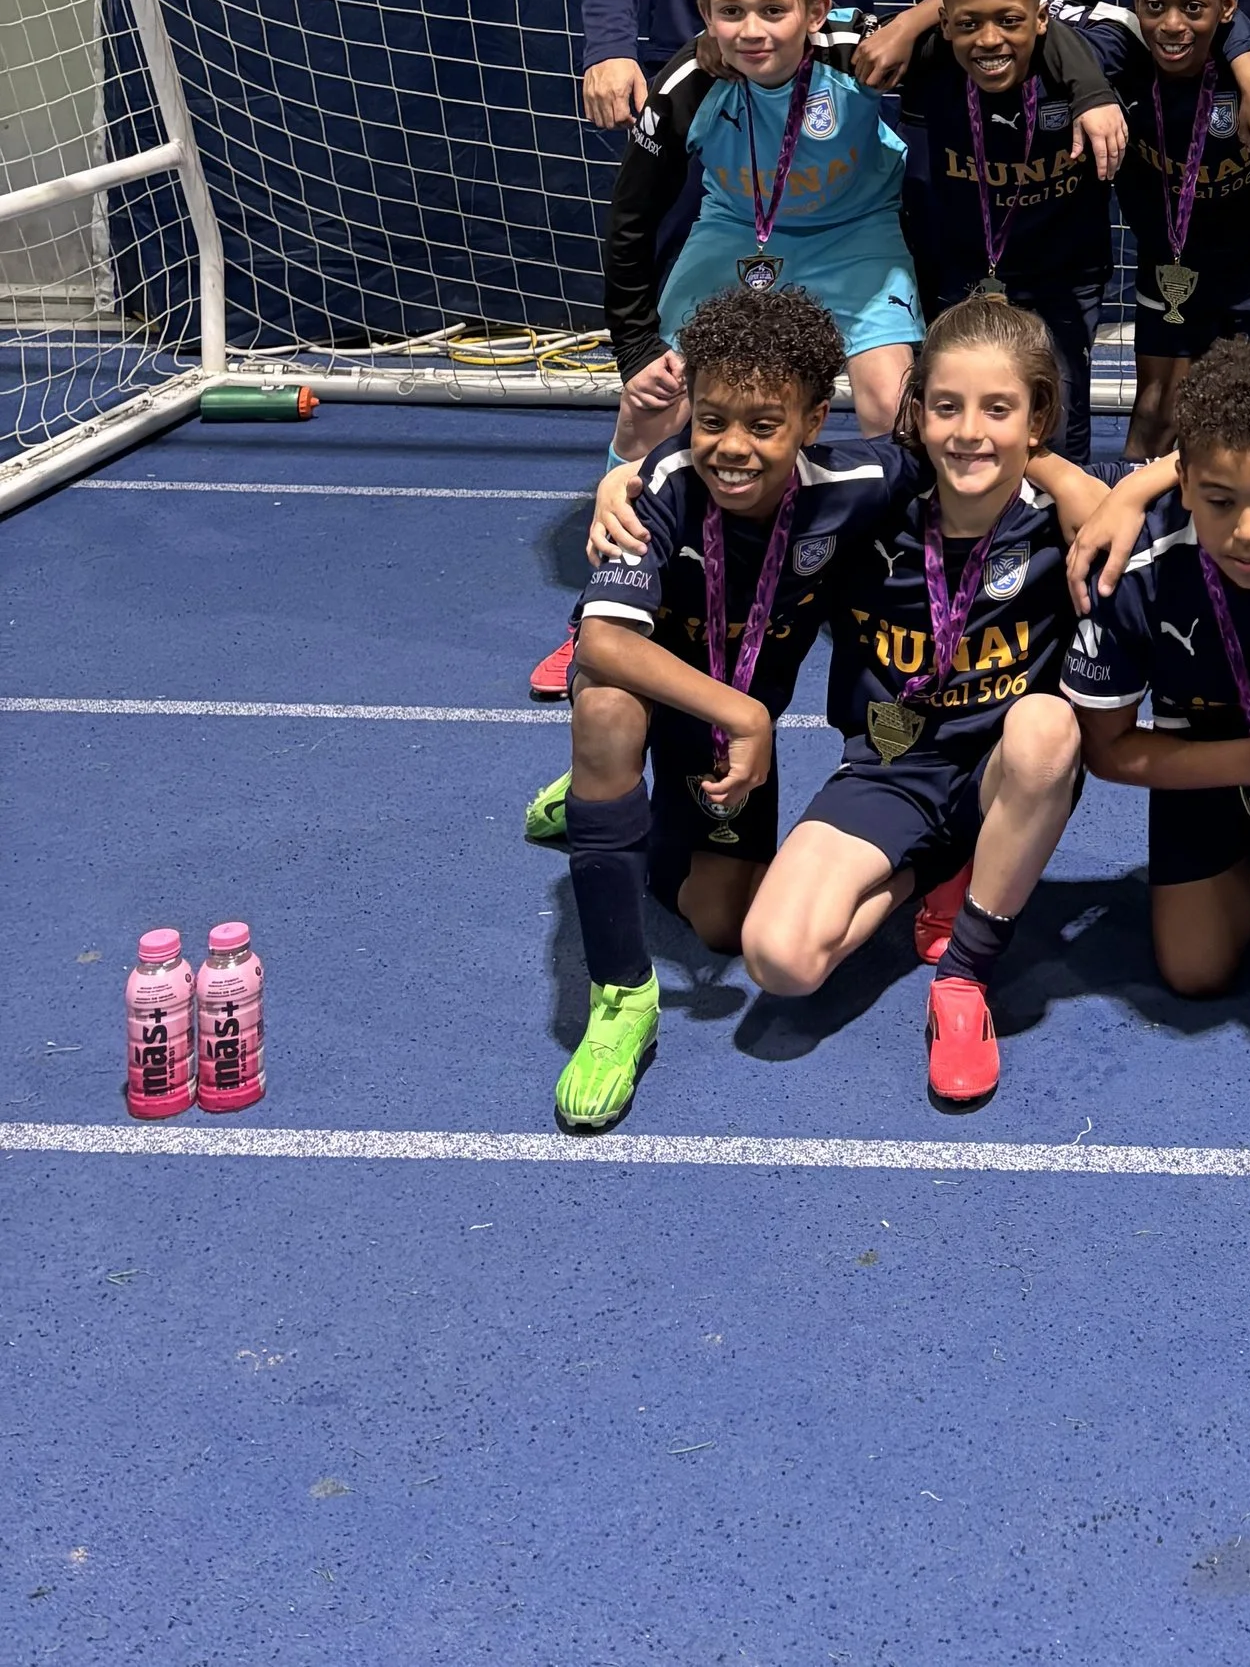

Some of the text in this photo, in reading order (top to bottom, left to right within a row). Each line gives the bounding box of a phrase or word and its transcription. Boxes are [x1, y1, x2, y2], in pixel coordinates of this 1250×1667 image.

[996, 174, 1083, 207] Local 50
[977, 670, 1030, 704] 506
